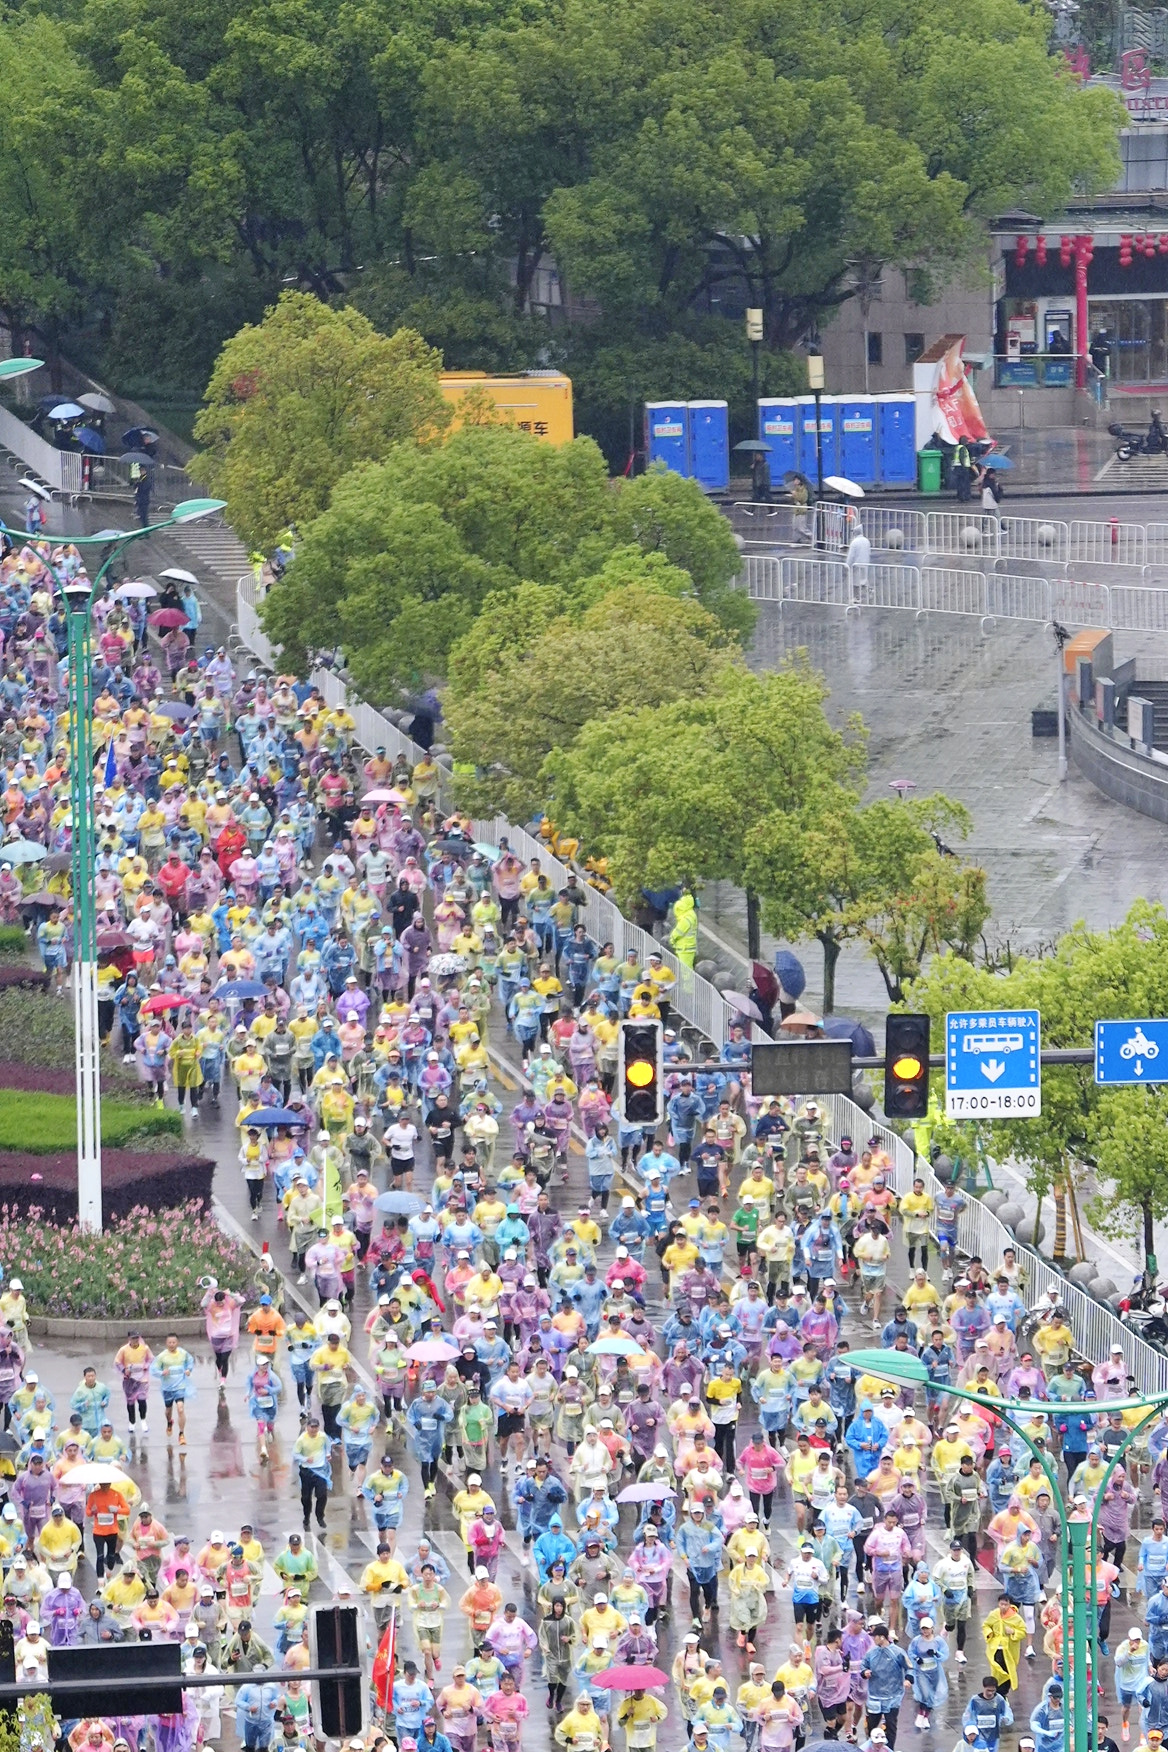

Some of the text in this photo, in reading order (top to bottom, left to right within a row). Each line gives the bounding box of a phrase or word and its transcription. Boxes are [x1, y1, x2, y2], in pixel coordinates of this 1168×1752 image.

[950, 1016, 1036, 1030] 允许多乘员车辆驶入
[951, 1094, 1036, 1110] 17:00-18:00
